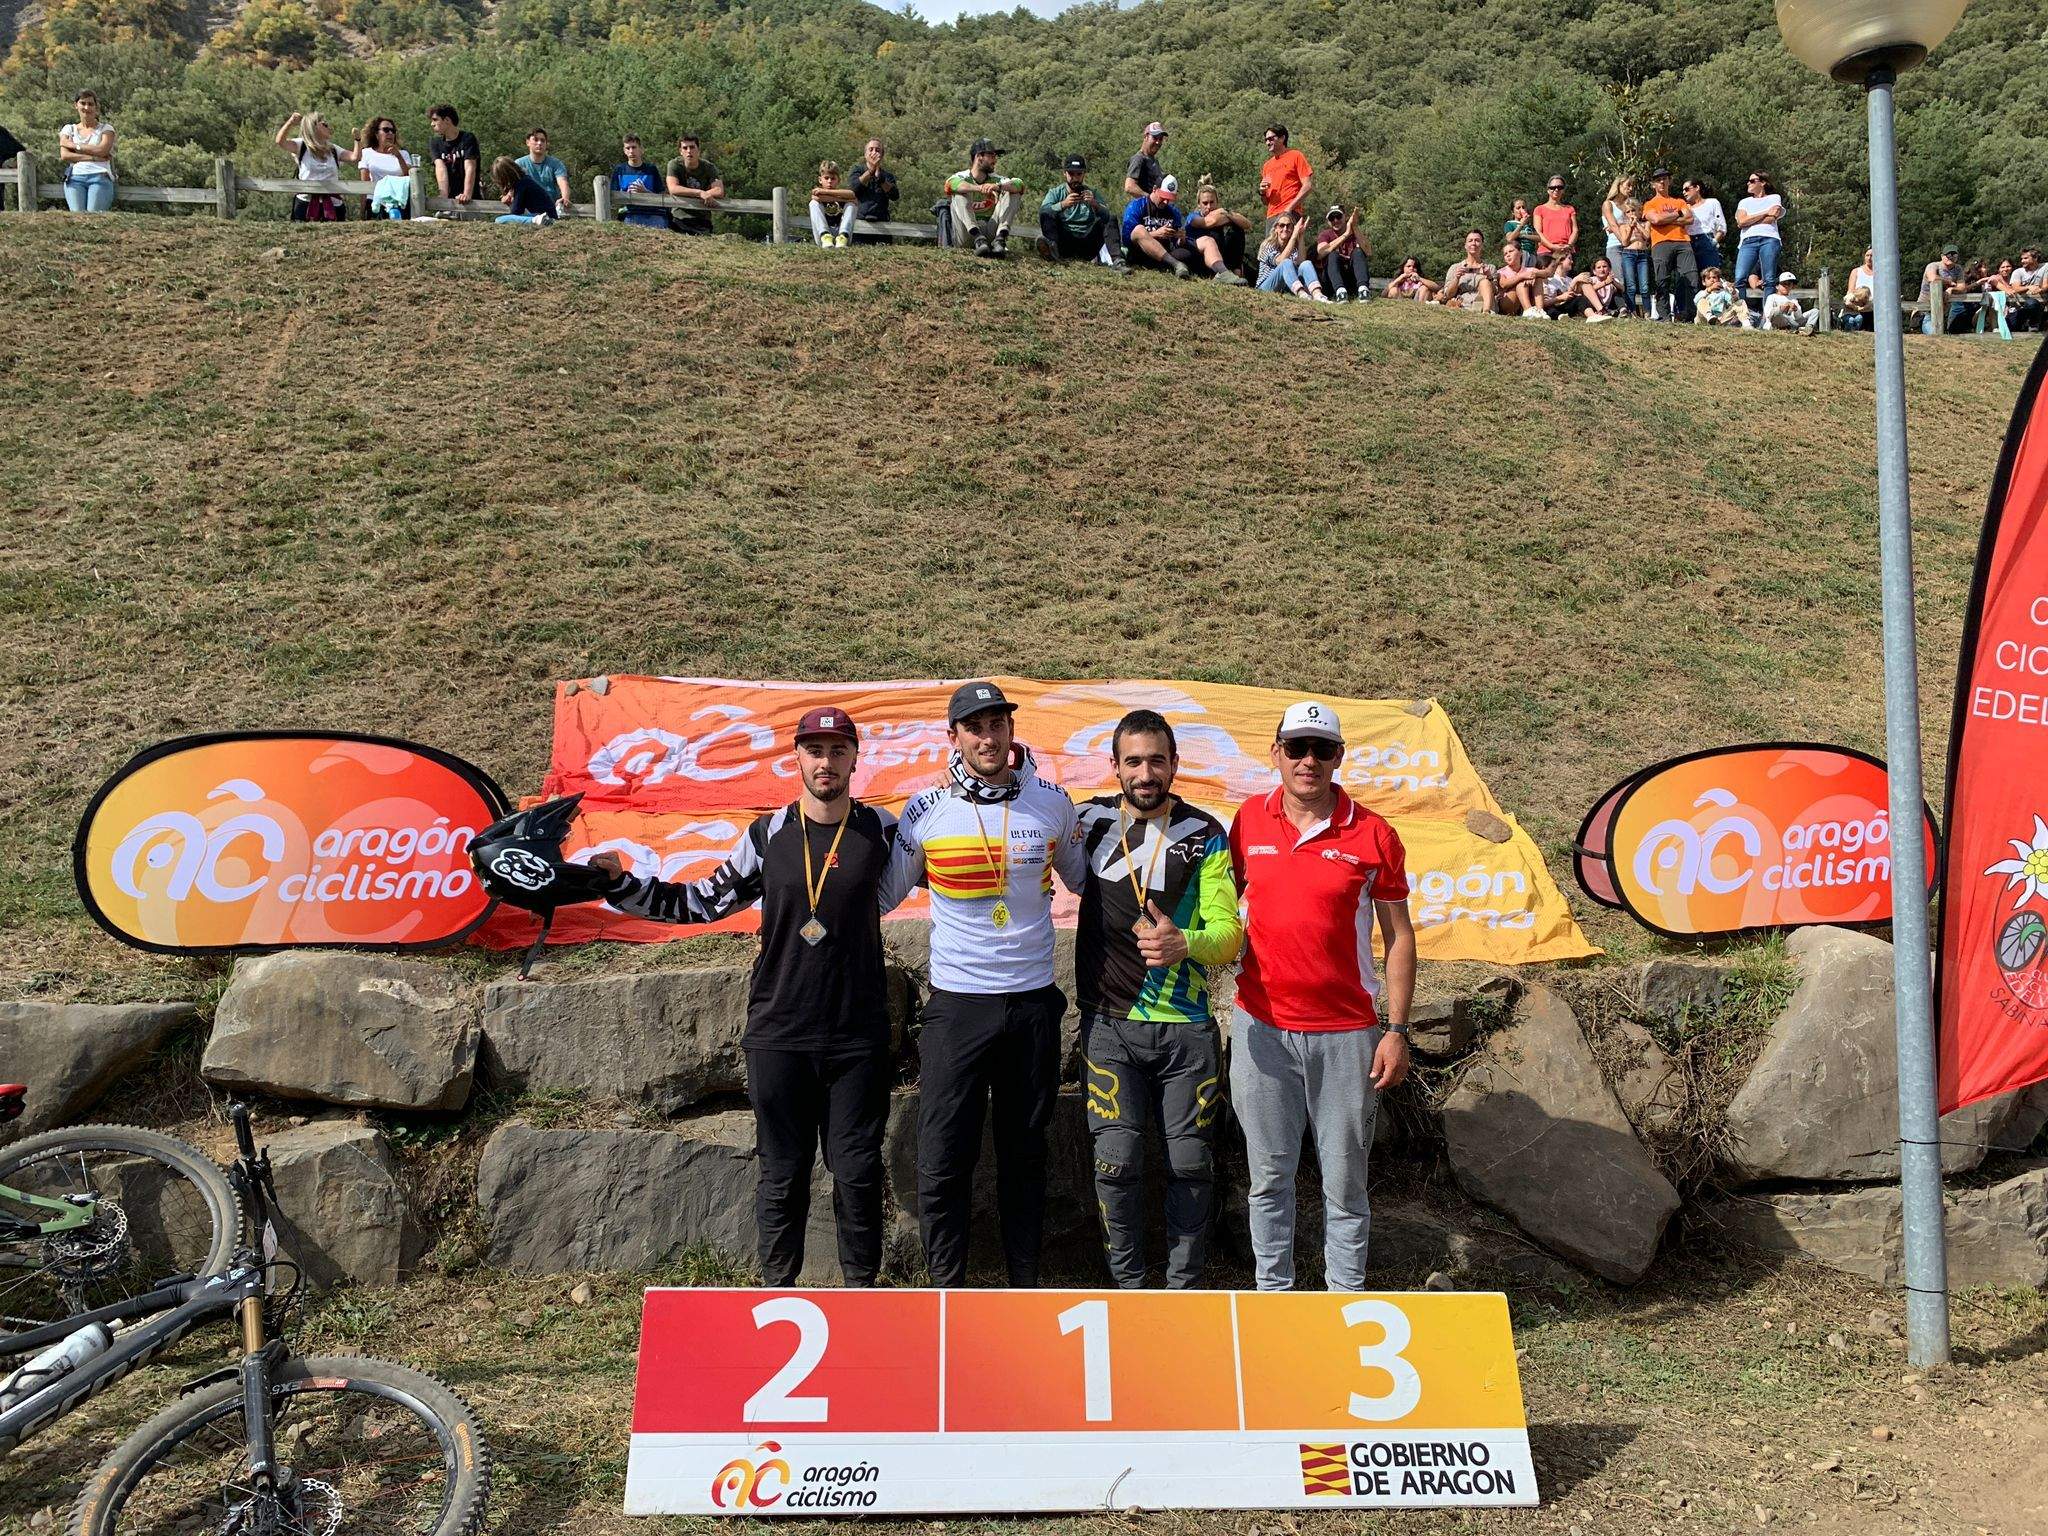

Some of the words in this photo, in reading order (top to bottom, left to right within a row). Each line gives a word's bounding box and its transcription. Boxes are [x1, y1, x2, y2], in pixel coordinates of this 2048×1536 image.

[313, 816, 473, 865] aragón
[1783, 810, 1890, 852] aragó
[277, 863, 472, 902] ciclismo
[1762, 853, 1892, 891] ciclism
[742, 1297, 830, 1425] 2
[1057, 1299, 1113, 1423] 1
[1340, 1299, 1423, 1423] 3
[802, 1461, 880, 1487] aragón
[1350, 1441, 1490, 1468] GOBIERNO
[786, 1486, 878, 1508] ciclismo
[1353, 1470, 1391, 1496] DE
[1400, 1469, 1517, 1495] ARAGON
